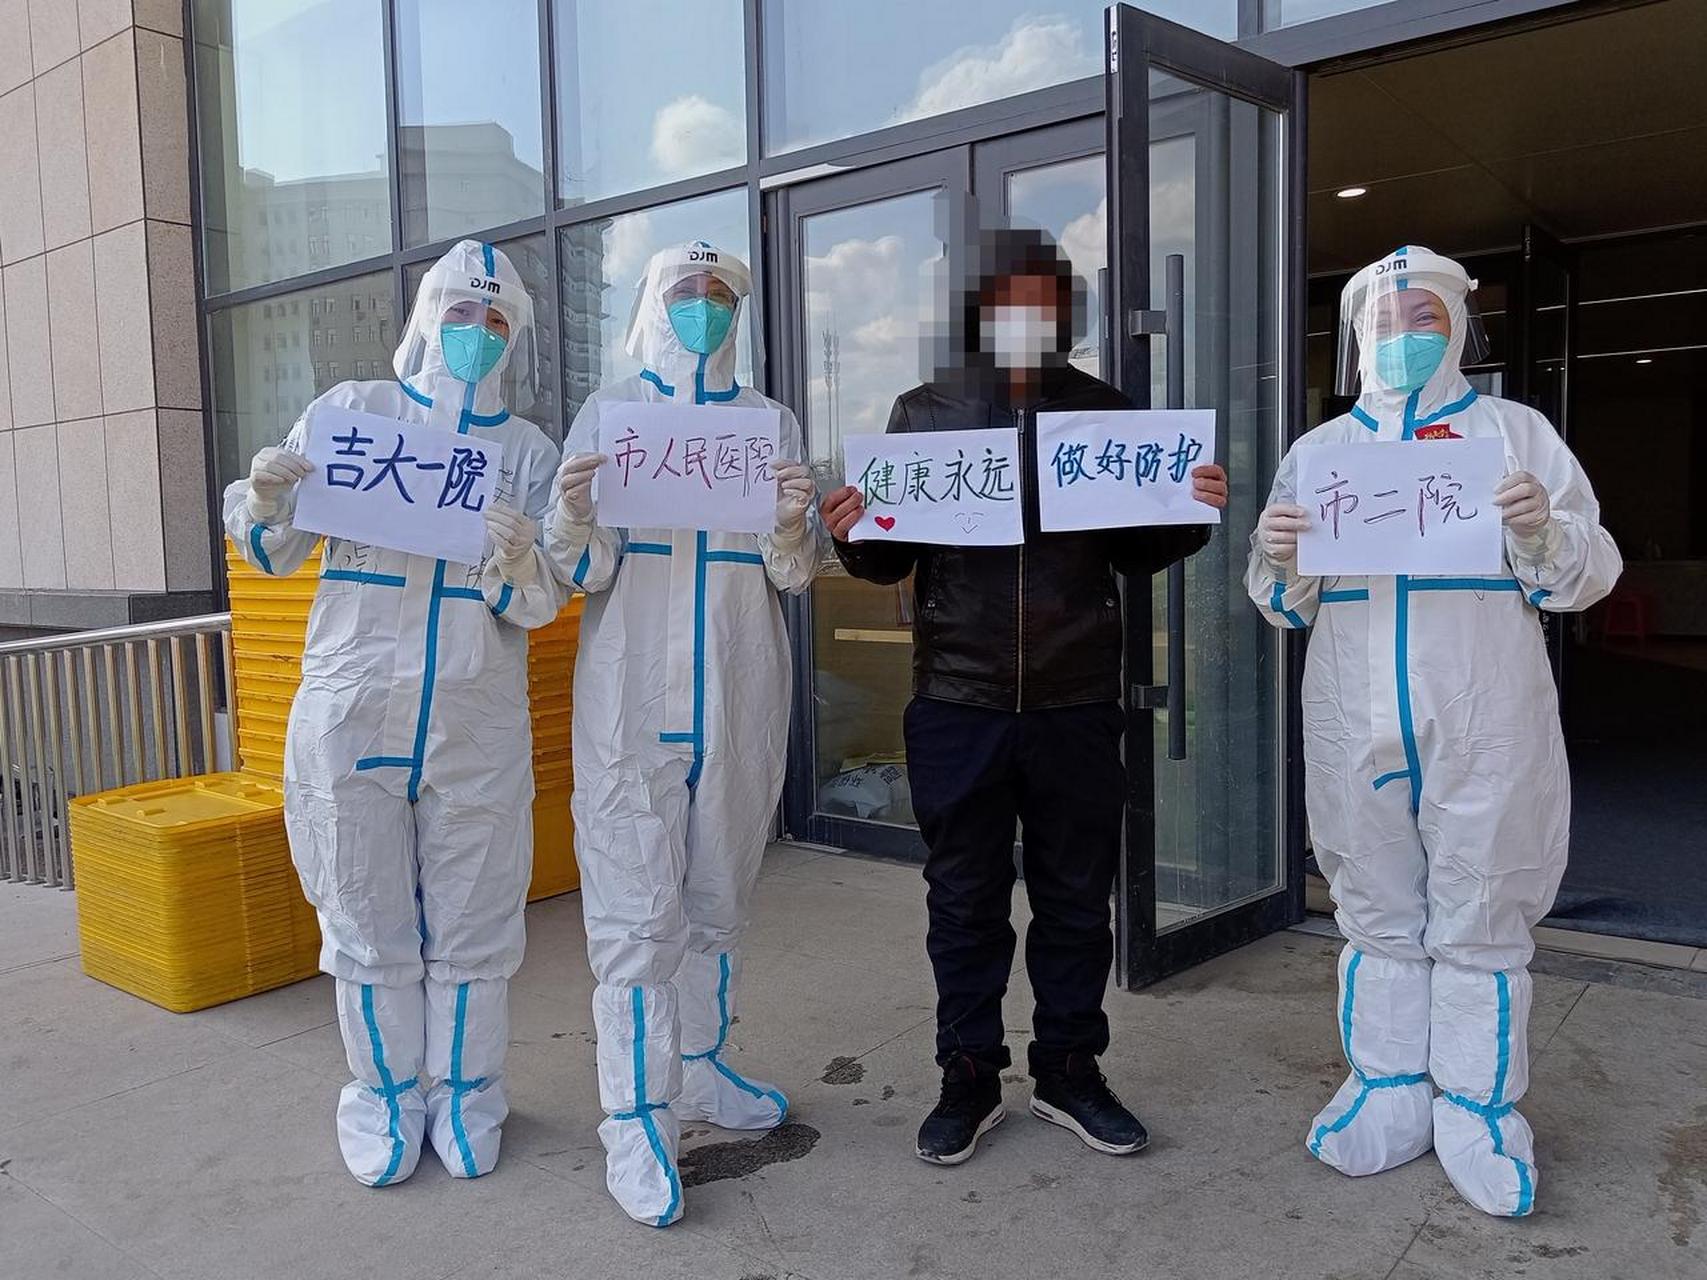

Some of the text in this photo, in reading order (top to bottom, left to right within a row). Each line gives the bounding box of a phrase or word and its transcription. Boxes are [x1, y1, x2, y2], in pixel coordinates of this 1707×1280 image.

[326, 426, 487, 512] 吉大一院
[615, 427, 774, 497] 市人民医院
[858, 447, 1014, 509] 健康永远
[1050, 433, 1203, 488] 做好防护
[1315, 471, 1478, 540] 市二院
